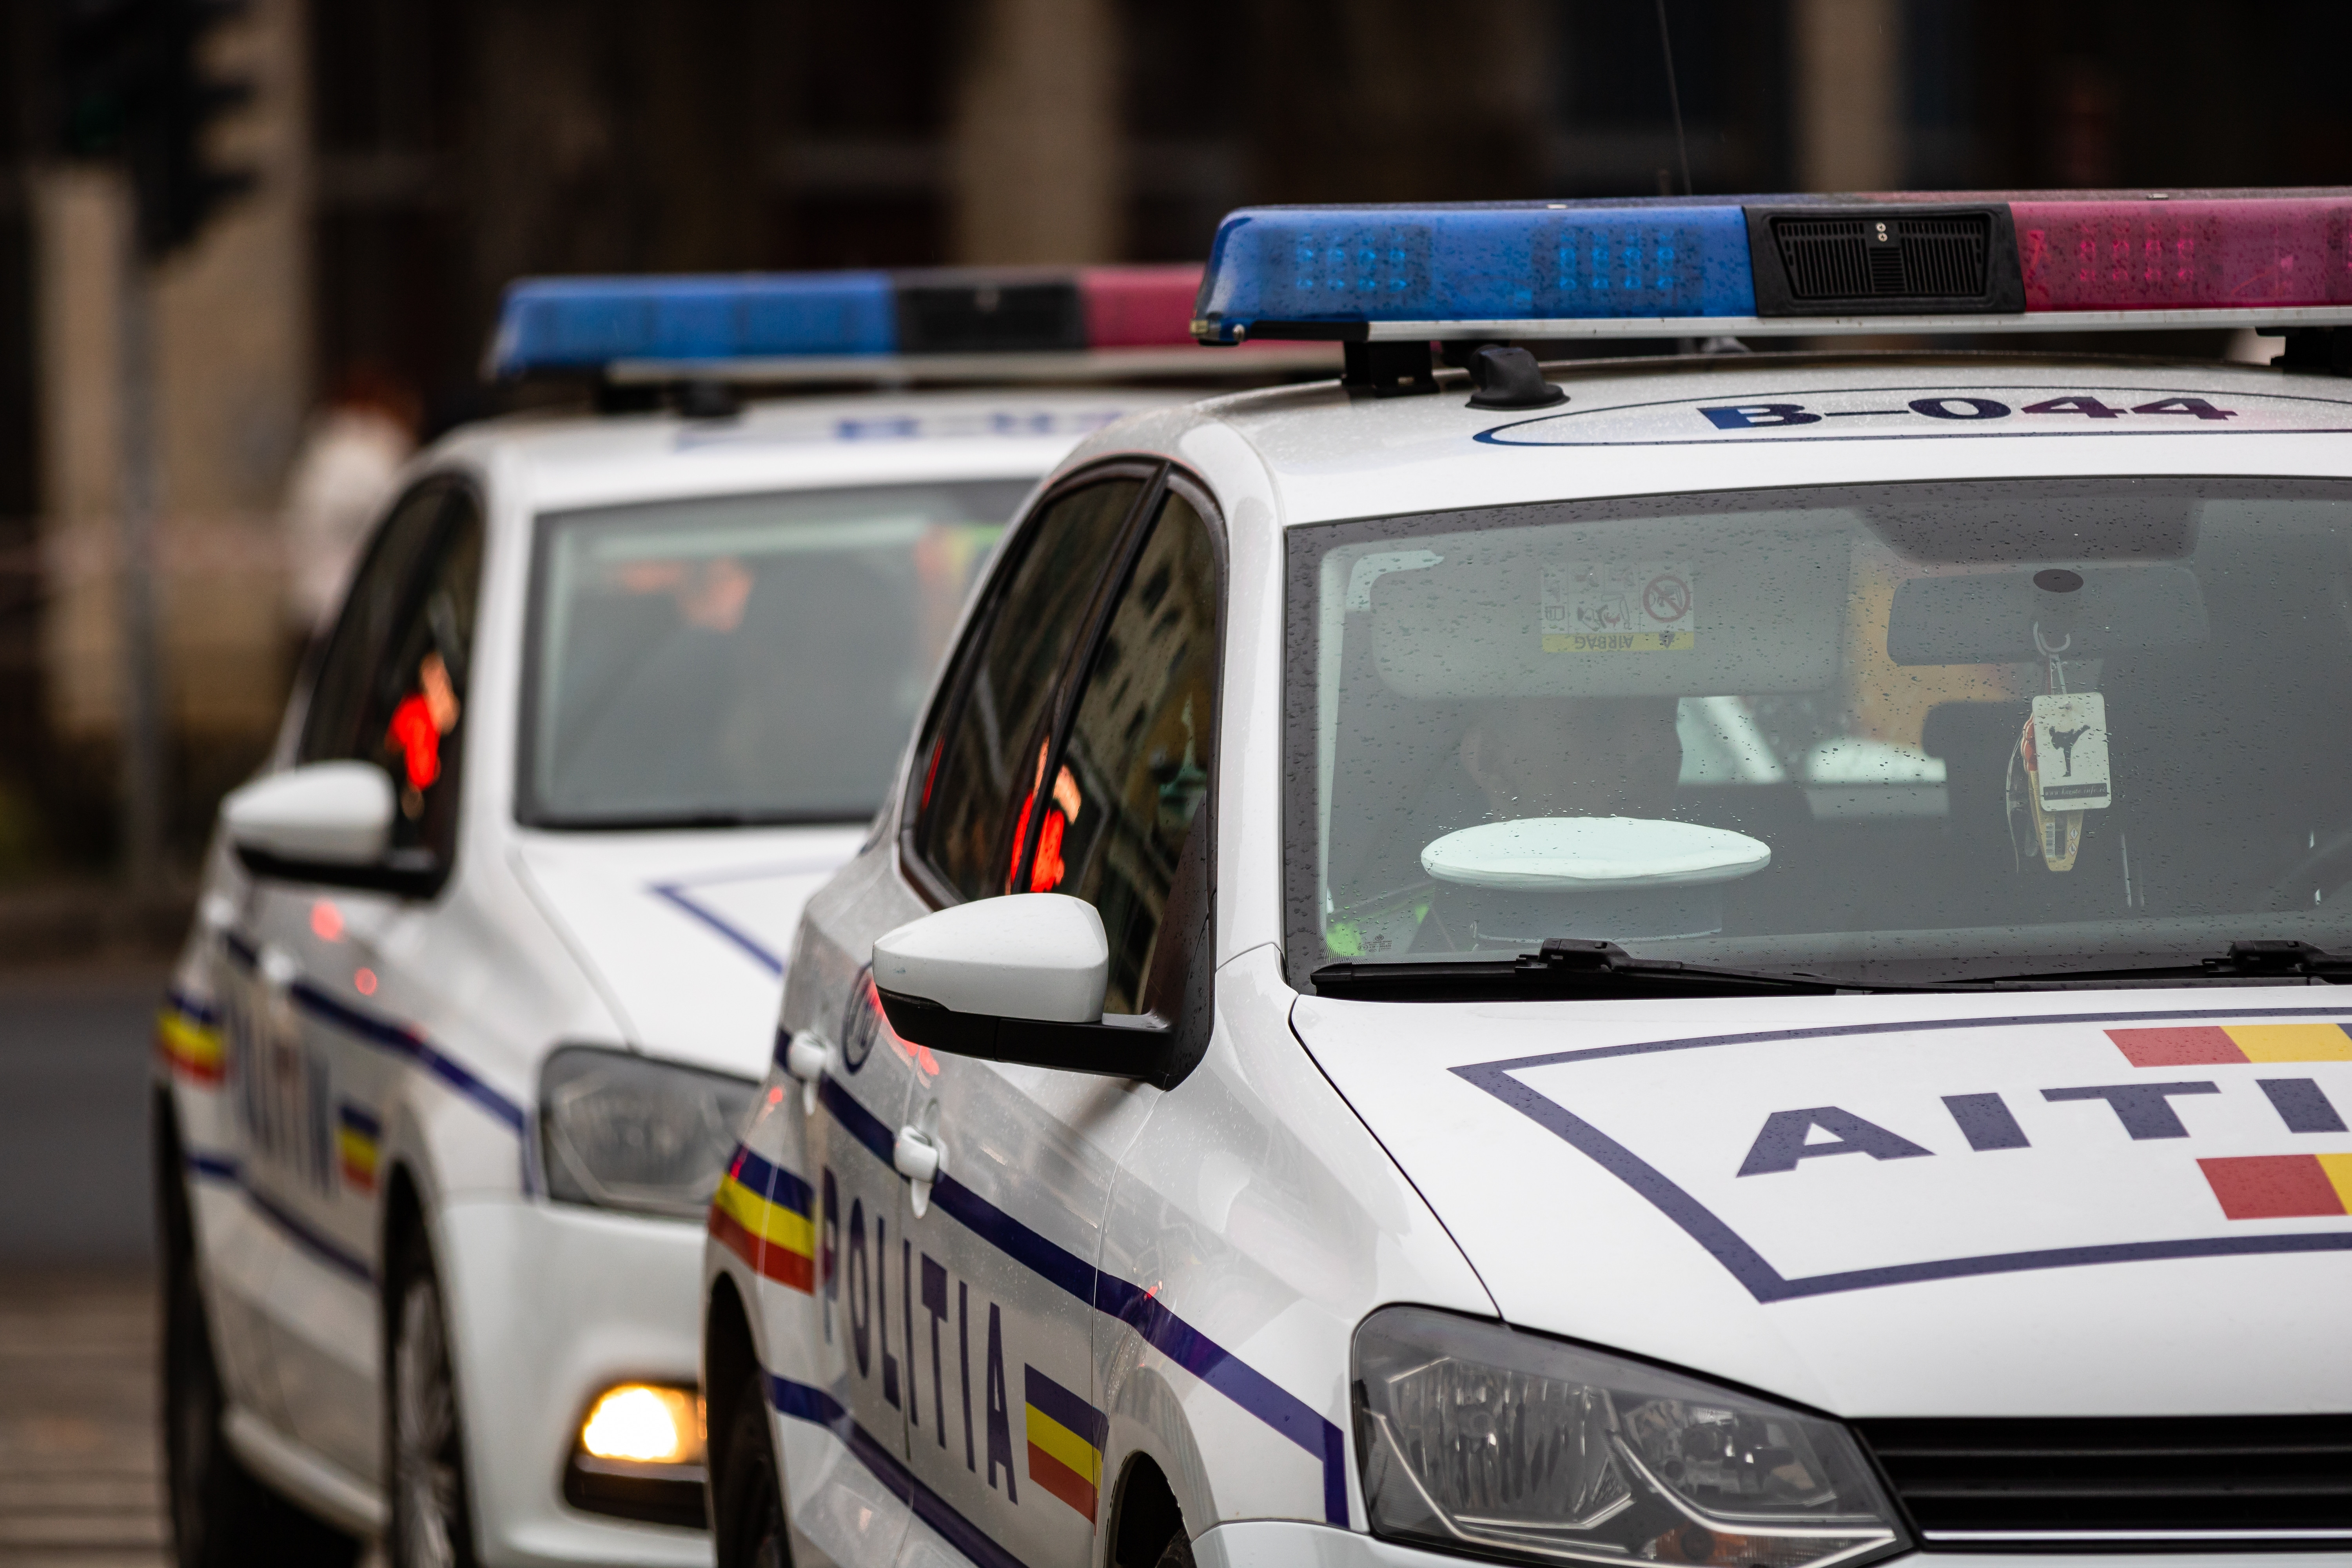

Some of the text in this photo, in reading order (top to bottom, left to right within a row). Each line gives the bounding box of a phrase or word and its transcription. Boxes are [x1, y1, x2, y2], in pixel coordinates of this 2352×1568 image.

[1695, 396, 2239, 430] B-044
[1574, 634, 1634, 650] AIRBAG
[823, 1165, 1019, 1506] POLITIA
